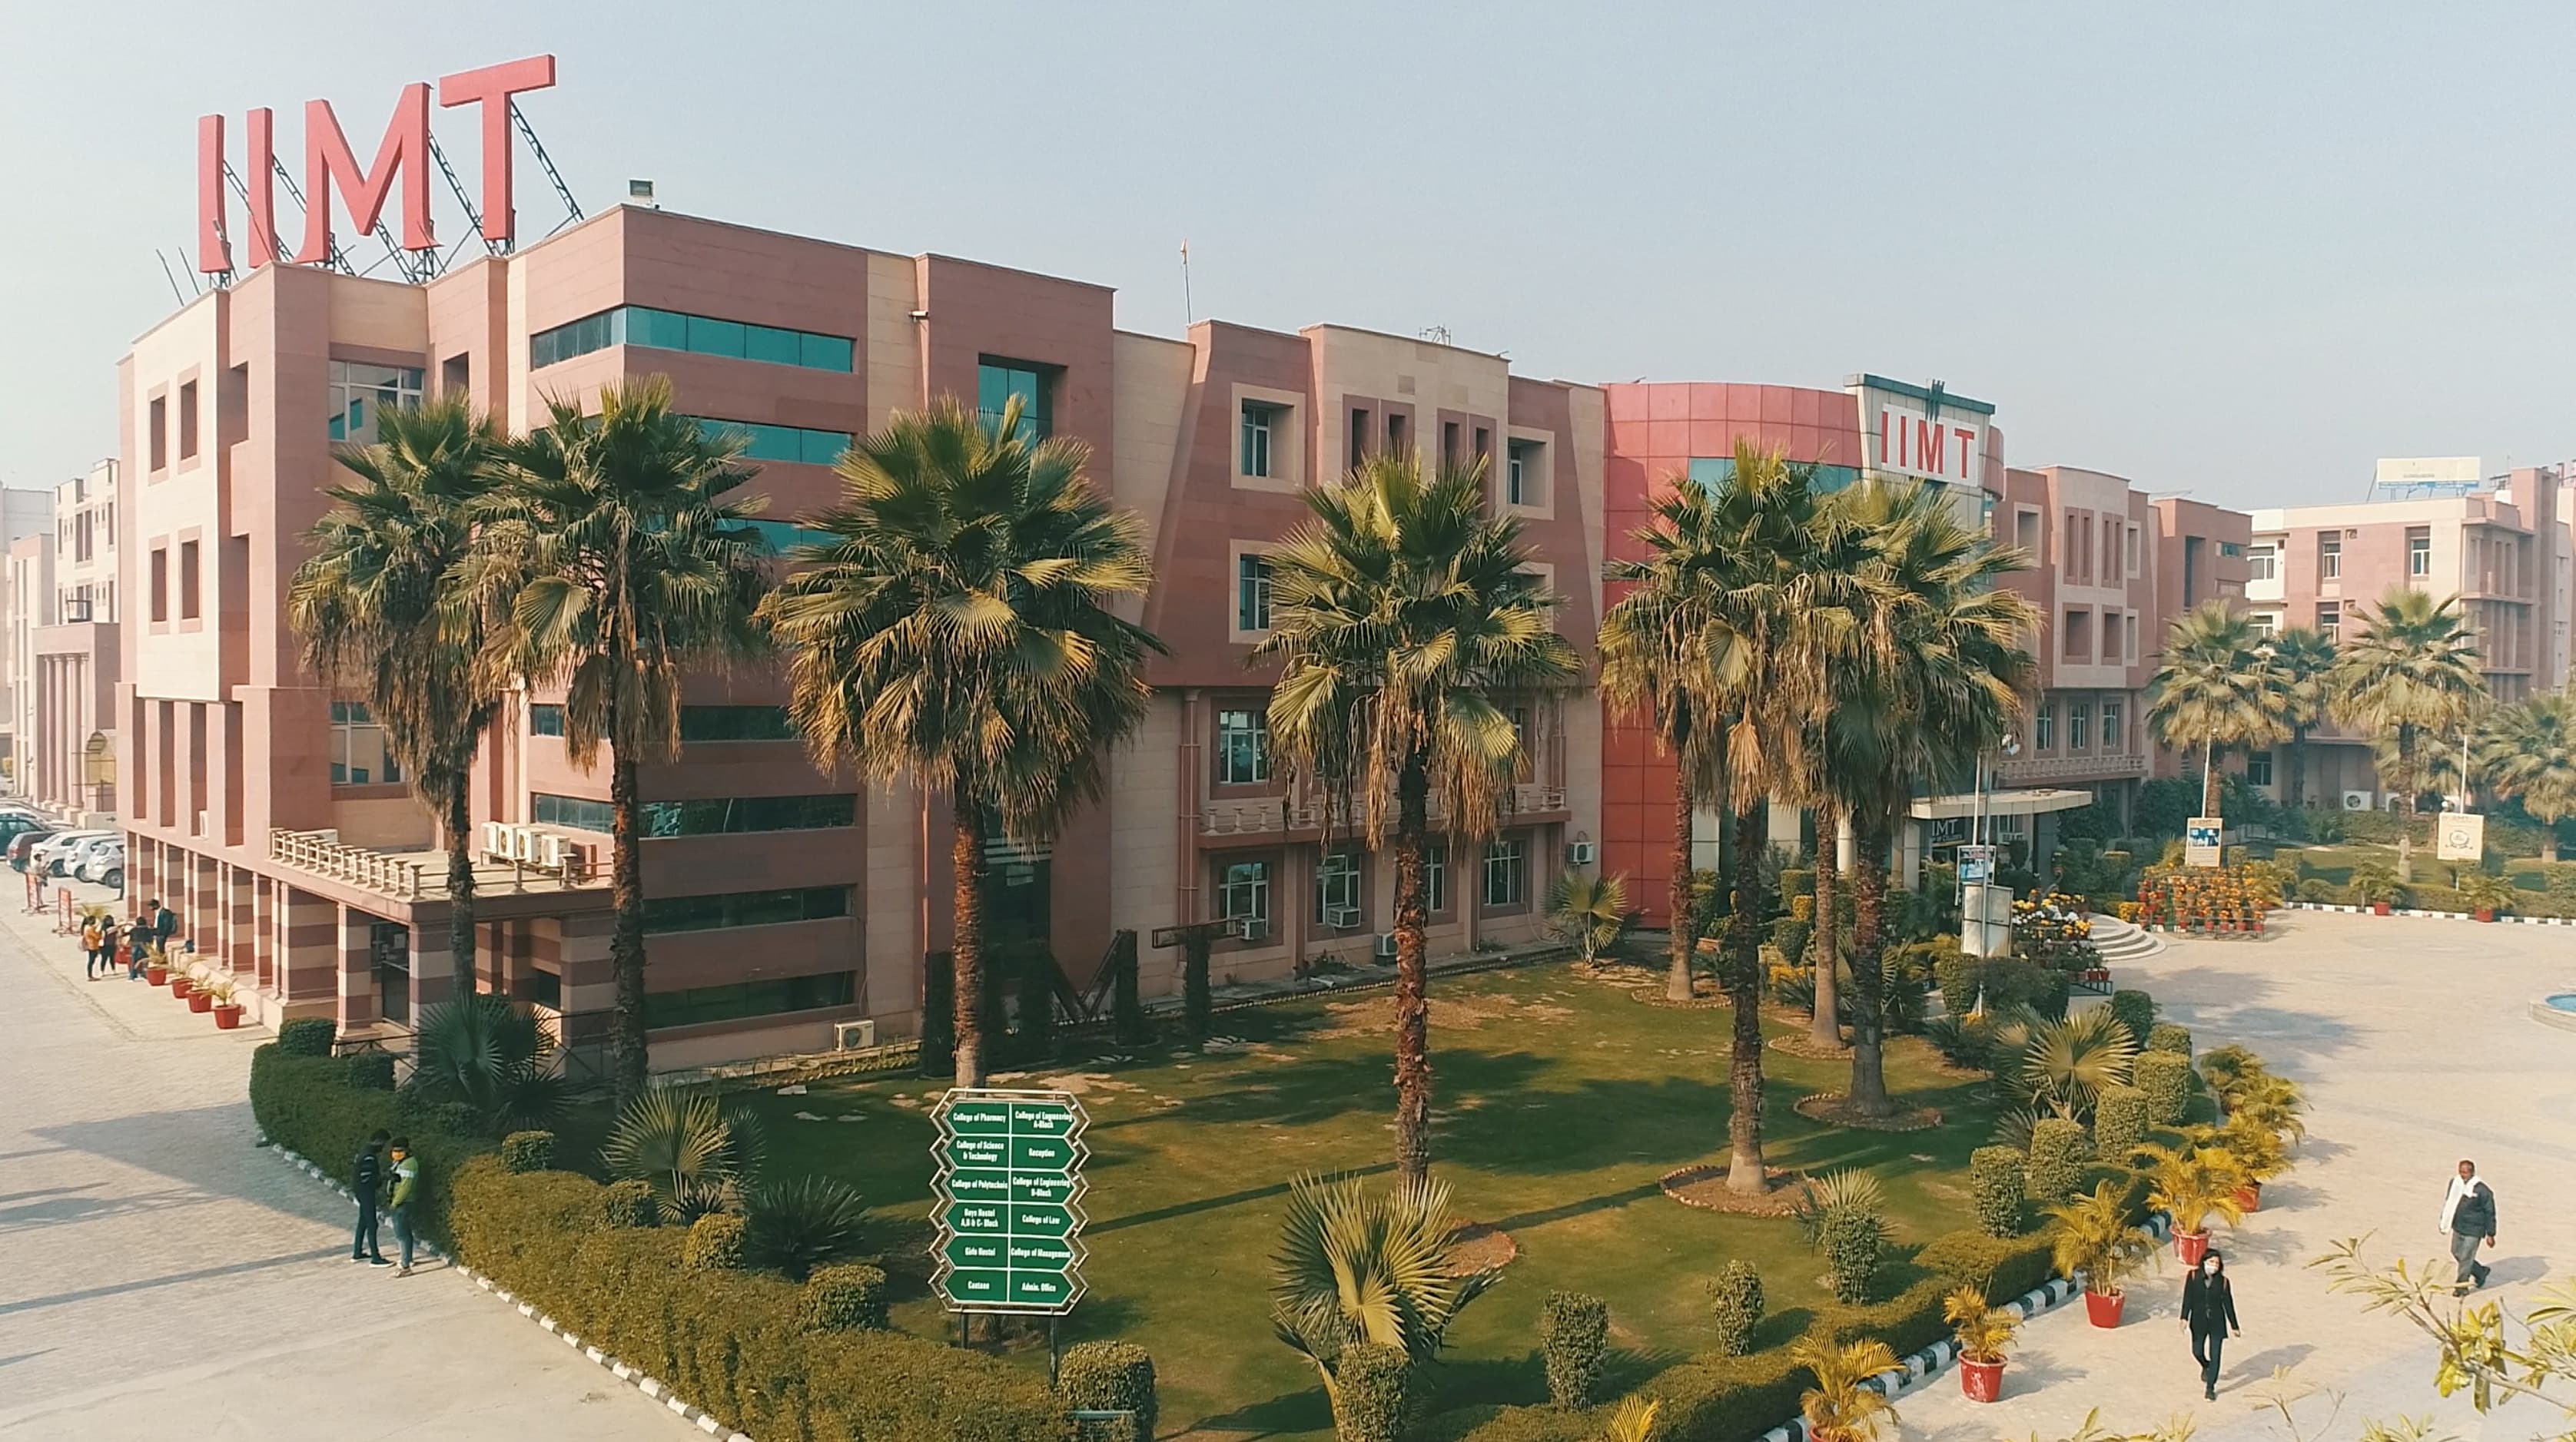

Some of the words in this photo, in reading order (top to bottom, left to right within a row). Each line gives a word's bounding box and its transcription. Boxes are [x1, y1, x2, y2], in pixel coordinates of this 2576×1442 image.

[198, 54, 556, 273] IIMT
[1881, 411, 1974, 479] IIMT
[953, 1112, 973, 1123] College
[974, 1112, 980, 1122] of
[980, 1112, 1007, 1124] Pharmacy
[1015, 1110, 1034, 1121] College
[1035, 1111, 1041, 1119] of
[957, 1140, 976, 1151] College
[977, 1140, 983, 1149] of
[983, 1140, 1004, 1150] Science
[968, 1152, 998, 1162] Technology
[1028, 1148, 1055, 1159] Reception
[951, 1178, 971, 1189] College
[972, 1179, 978, 1188] of
[1013, 1176, 1032, 1187] College
[1034, 1177, 1039, 1186] of
[1040, 1177, 1070, 1188] Engineering
[1021, 1214, 1041, 1225] College
[1043, 1215, 1048, 1224] of
[1049, 1215, 1061, 1225] Law
[1011, 1247, 1030, 1258] College
[1031, 1248, 1037, 1257] of
[1041, 1282, 1057, 1292] Office
